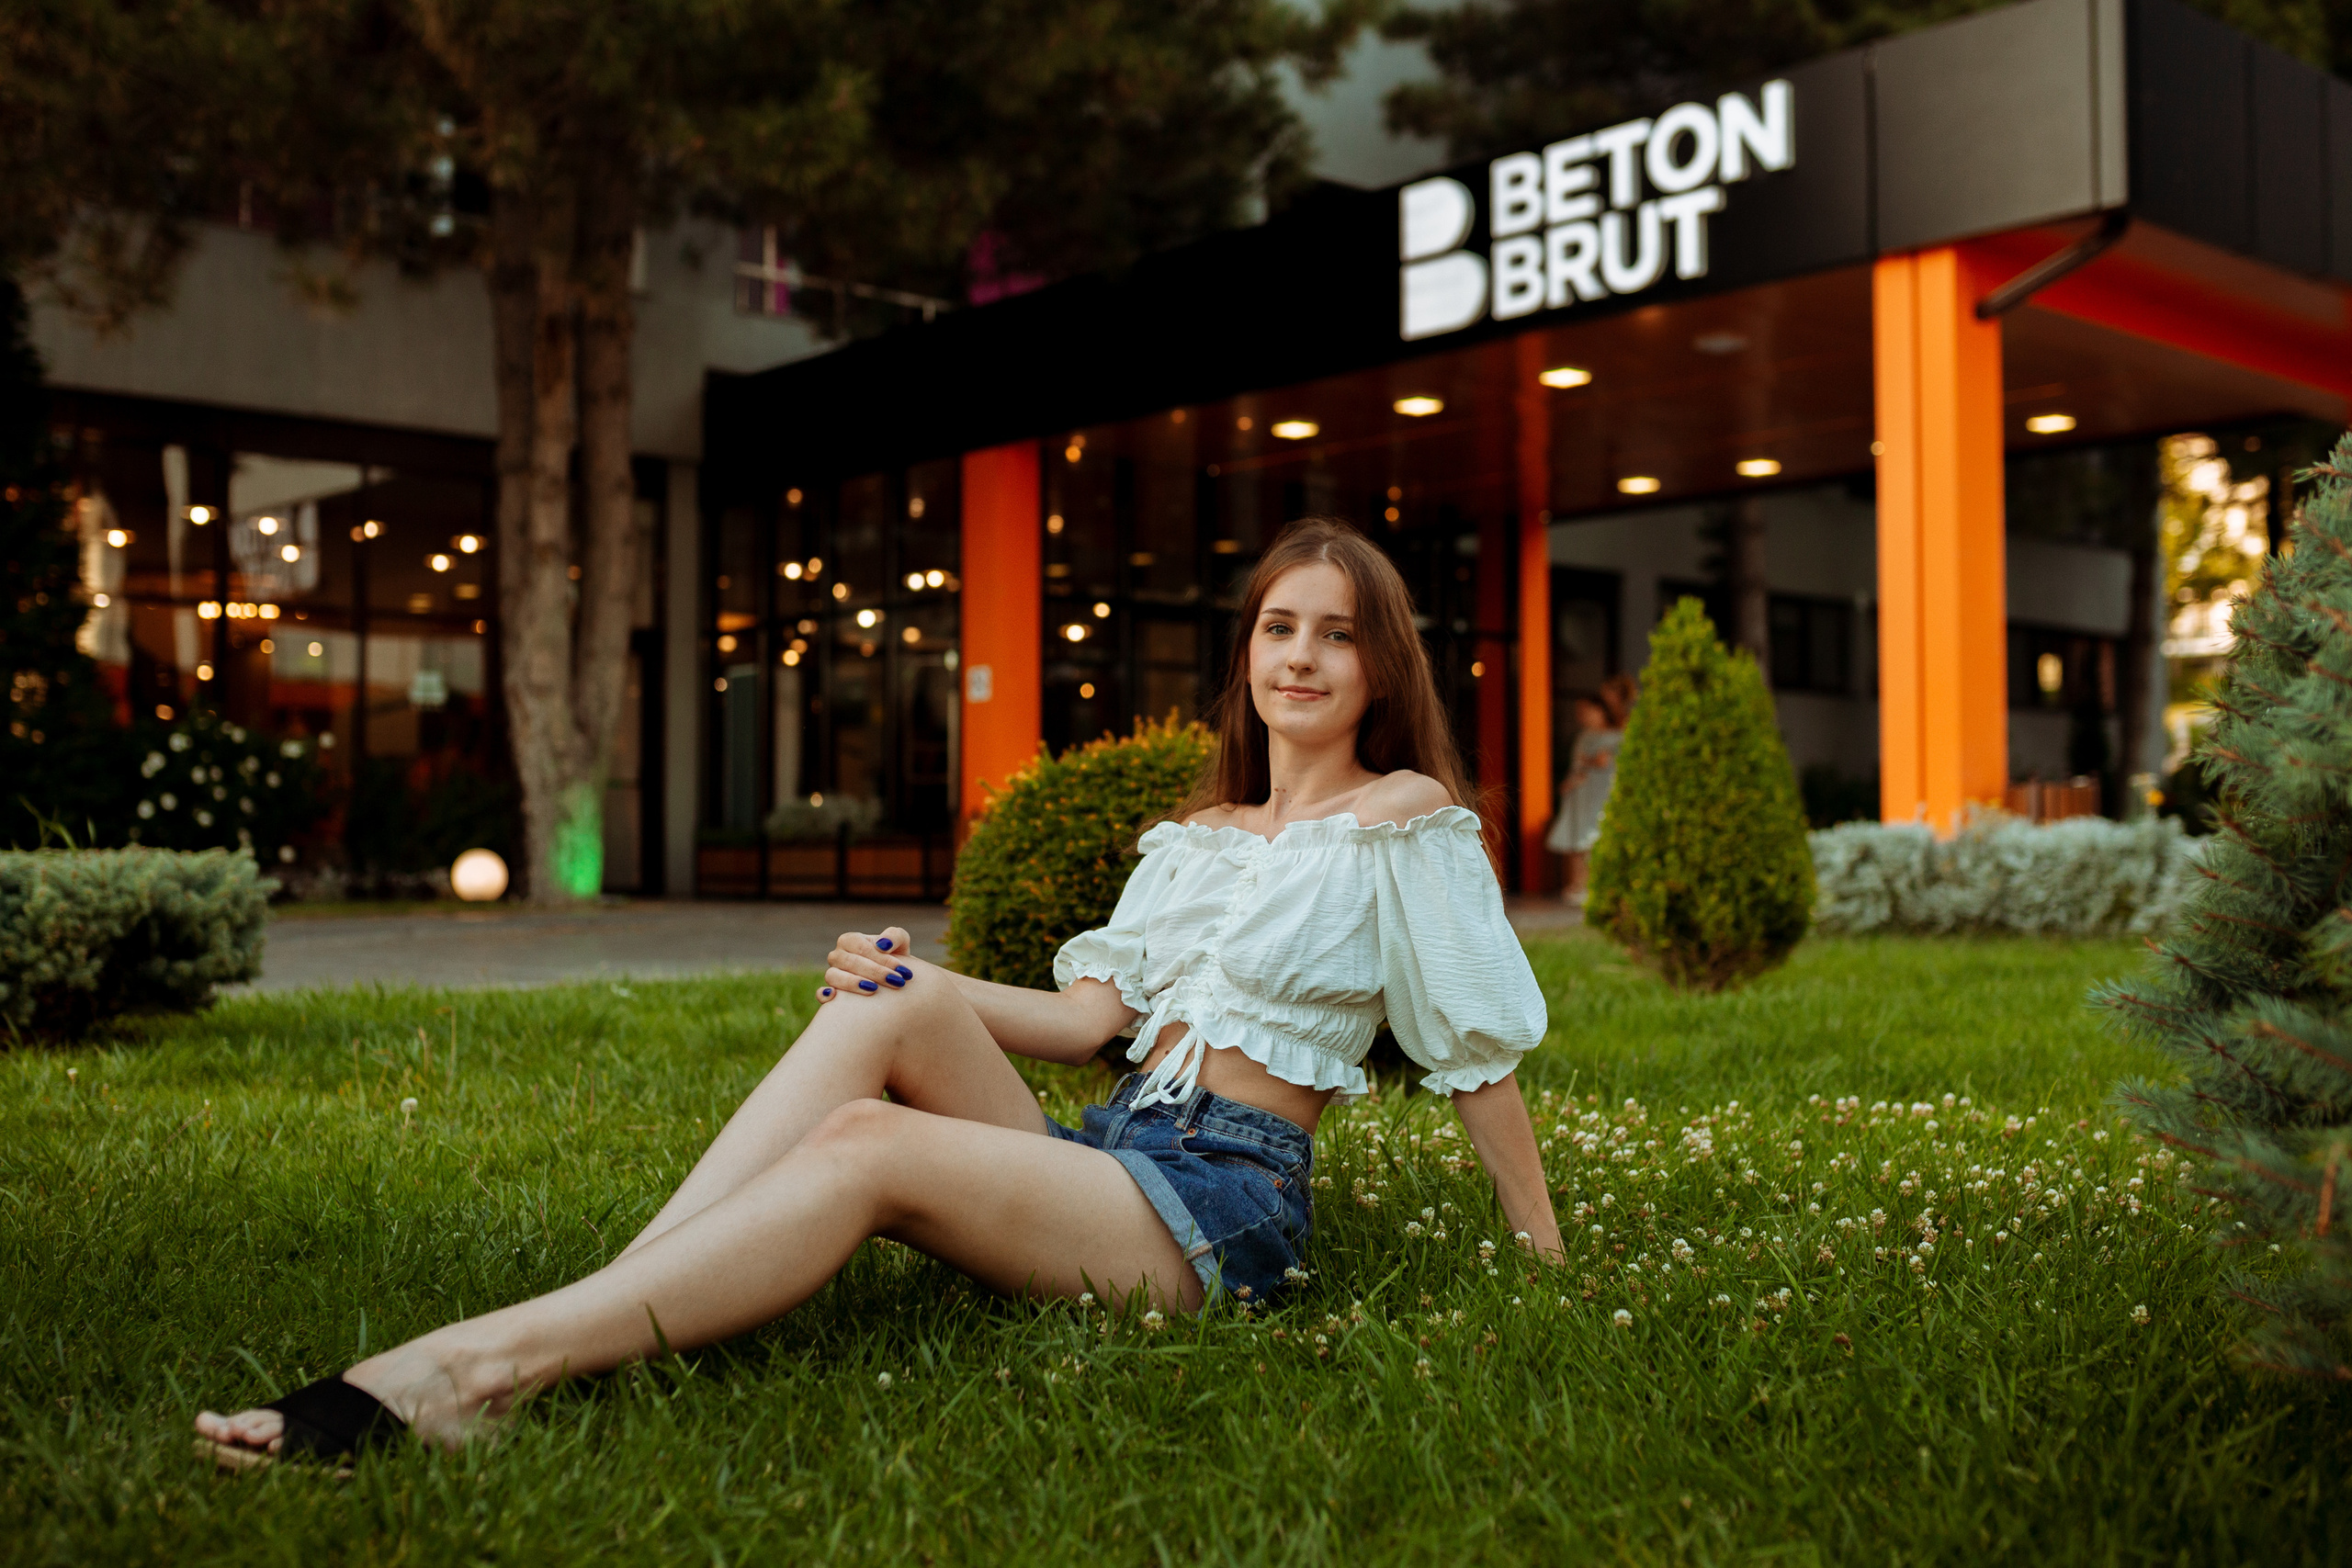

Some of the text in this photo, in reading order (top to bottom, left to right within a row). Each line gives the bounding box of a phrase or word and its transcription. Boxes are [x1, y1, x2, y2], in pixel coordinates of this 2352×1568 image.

[1490, 79, 1794, 240] BETON
[1399, 175, 1488, 342] B
[1490, 186, 1726, 321] BRUT
